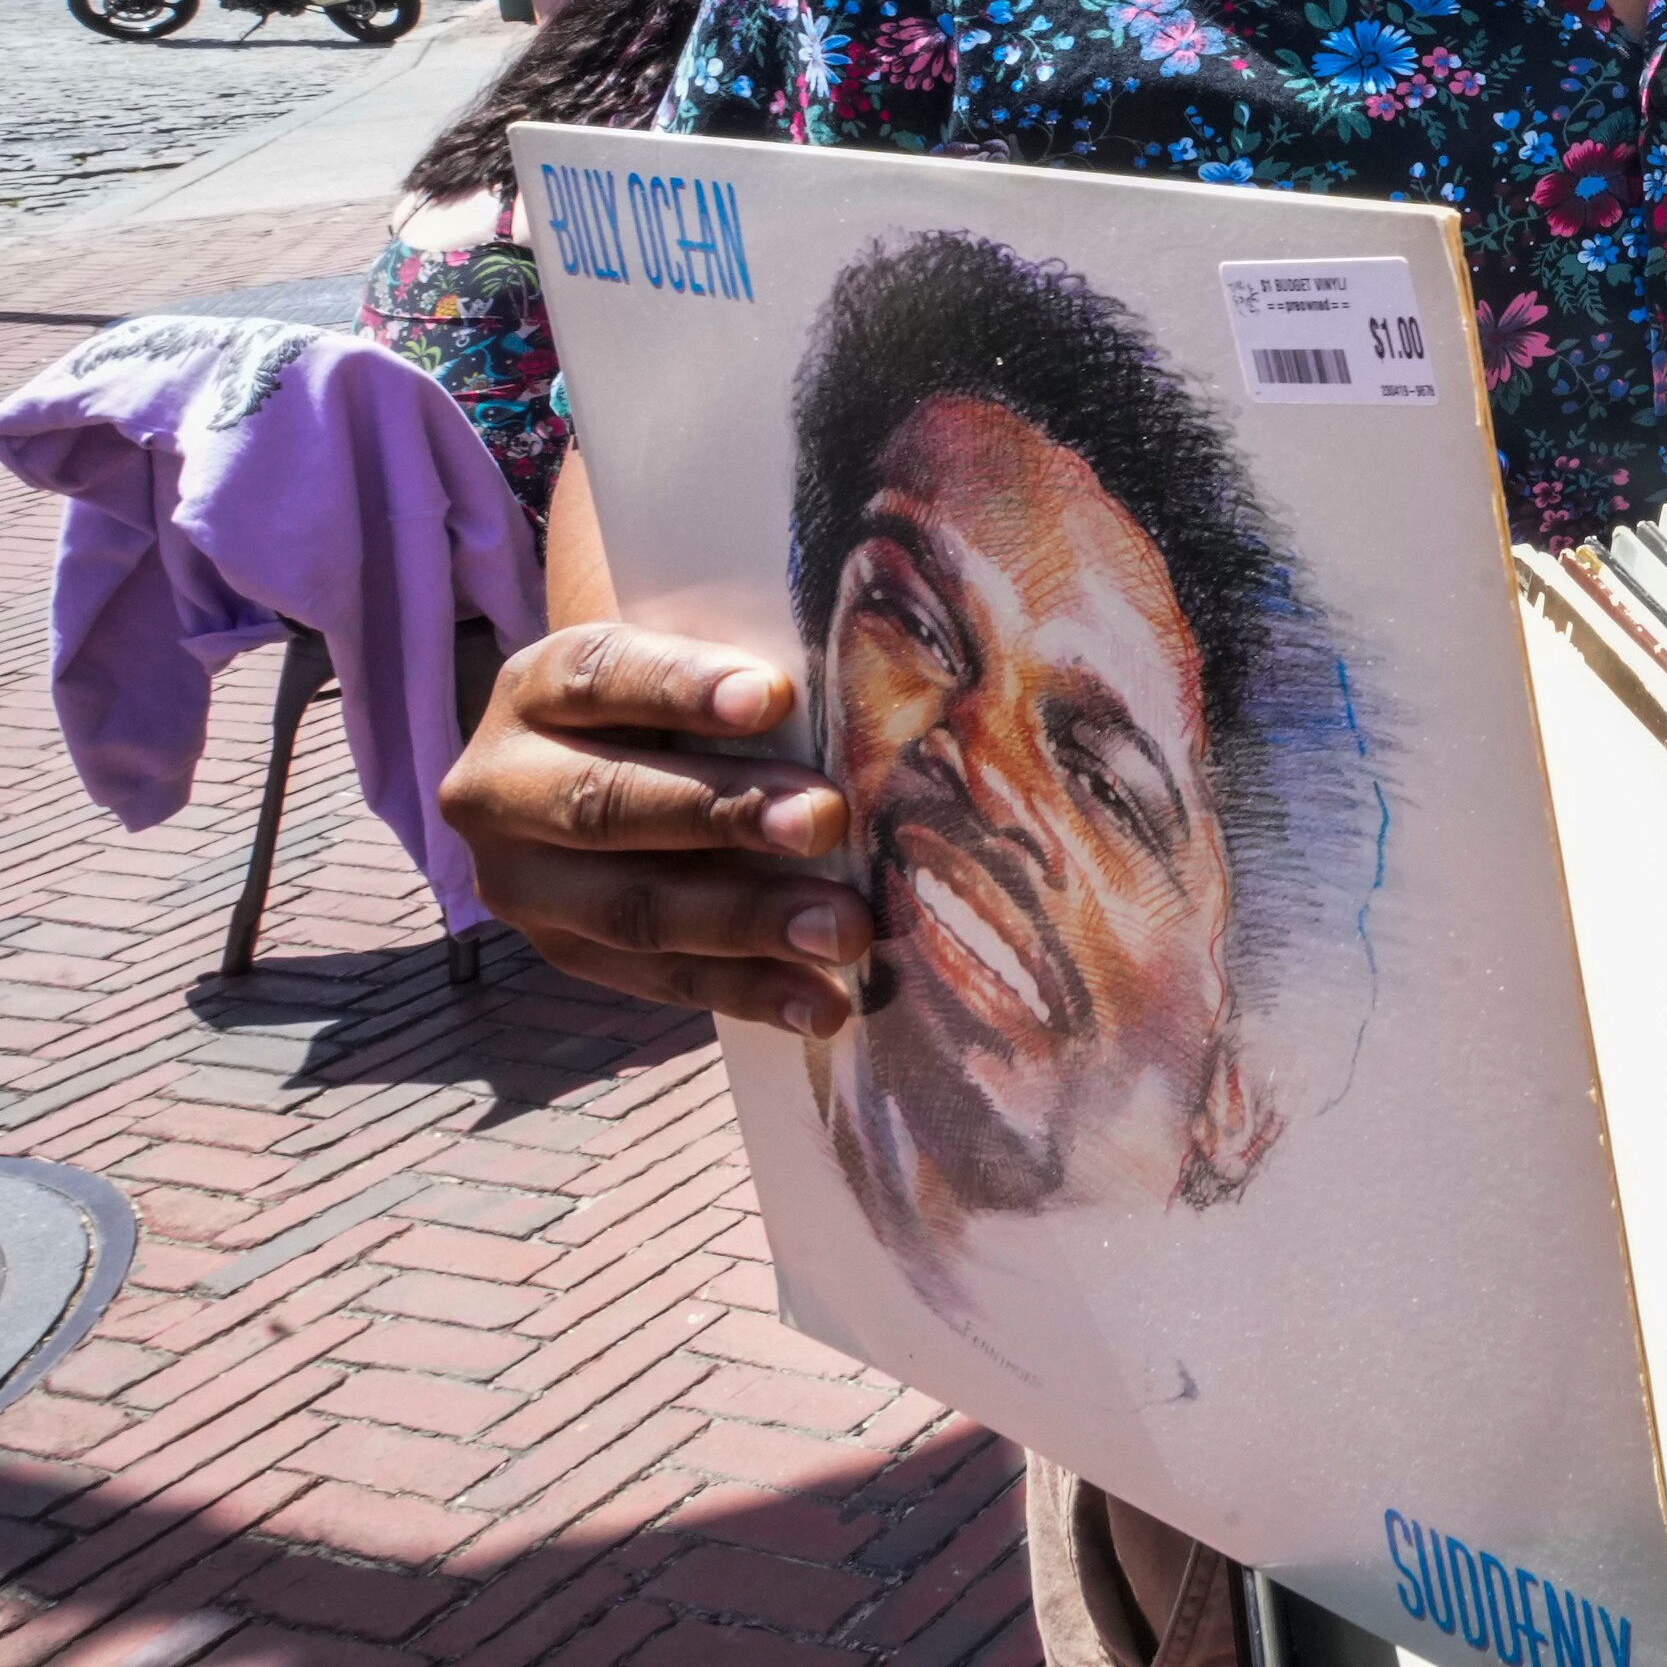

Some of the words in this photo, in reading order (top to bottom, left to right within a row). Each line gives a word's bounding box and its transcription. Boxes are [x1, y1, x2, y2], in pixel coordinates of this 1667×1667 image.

[540, 163, 630, 285] BILLY
[627, 172, 755, 304] OCEAN
[1275, 278, 1311, 293] BUDGET
[1368, 316, 1425, 361] $1.00
